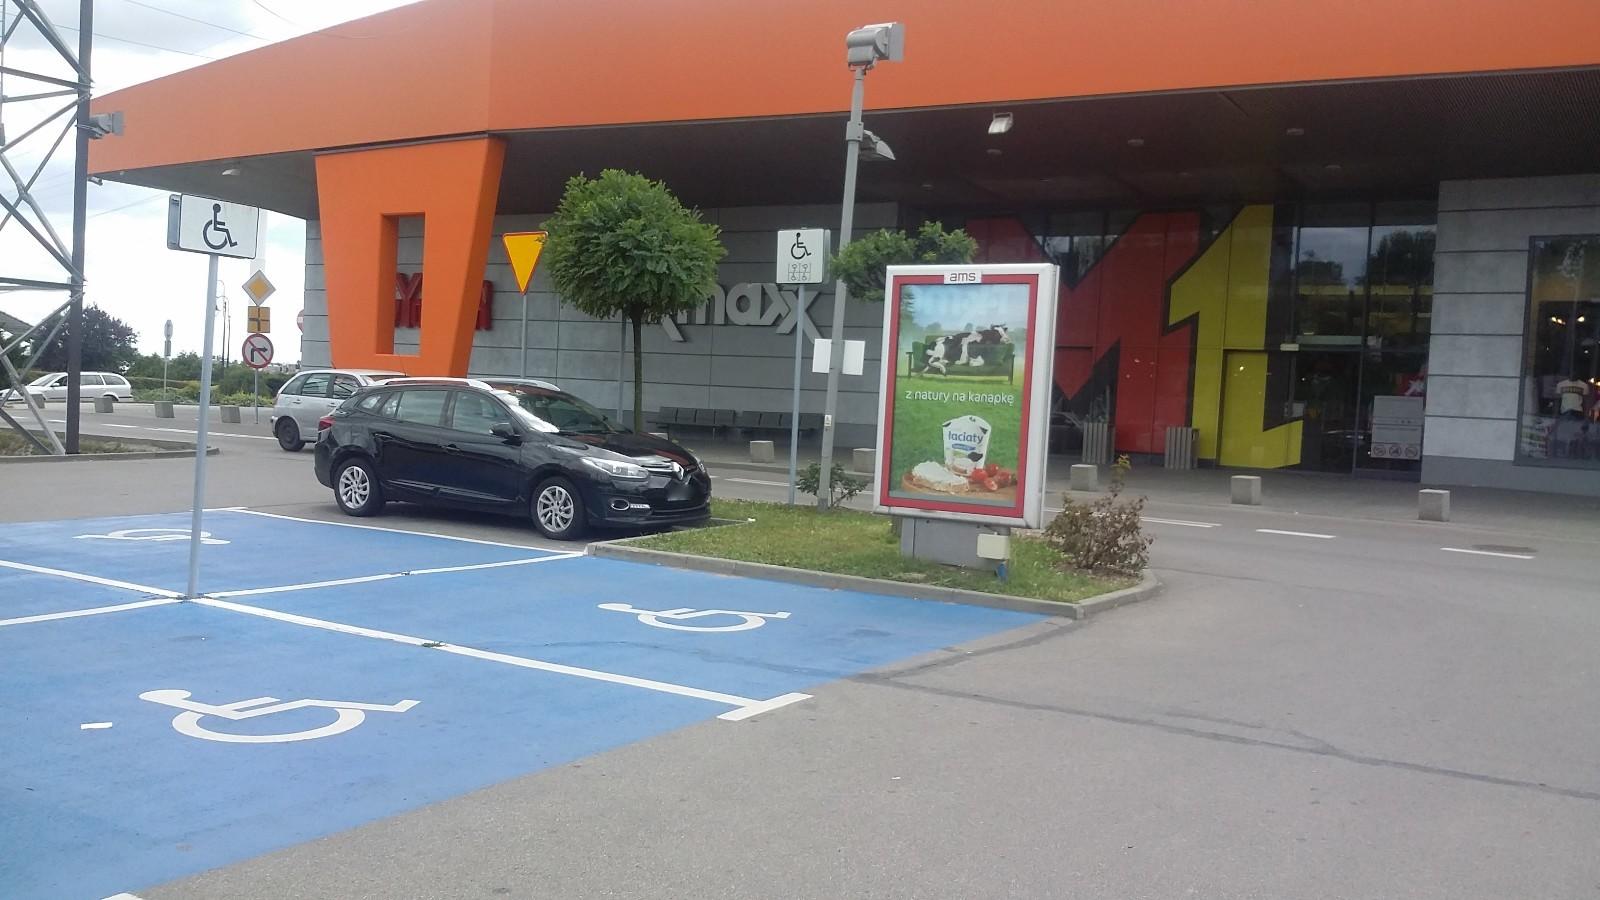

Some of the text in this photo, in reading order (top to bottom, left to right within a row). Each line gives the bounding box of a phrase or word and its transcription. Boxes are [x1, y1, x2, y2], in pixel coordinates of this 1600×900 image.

[949, 272, 976, 282] ams
[905, 390, 1015, 407] z natury na kanapkę
